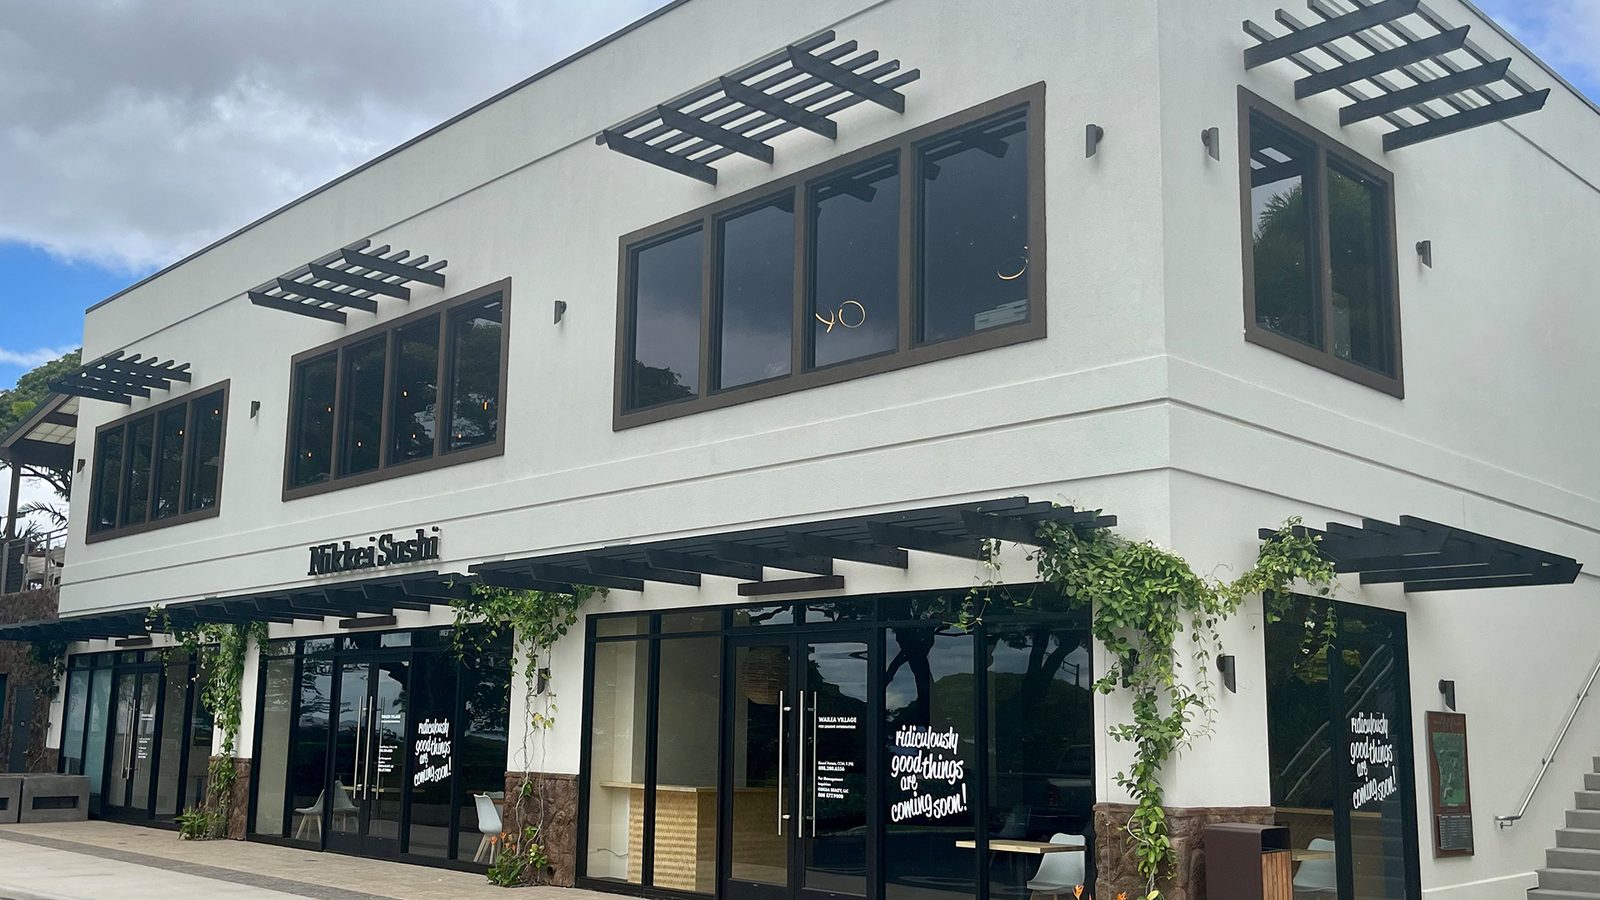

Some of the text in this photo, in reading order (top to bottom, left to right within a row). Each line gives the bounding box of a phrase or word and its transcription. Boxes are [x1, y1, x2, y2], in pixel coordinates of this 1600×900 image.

[308, 526, 440, 576] Nikkei Sushi
[415, 735, 451, 758] good things
[895, 724, 959, 755] ridiculously
[1350, 736, 1393, 768] good things
[414, 763, 435, 787] coming
[891, 749, 964, 785] good things
[900, 774, 918, 791] are
[891, 783, 968, 823] coming soon!
[1353, 765, 1397, 809] coming soon!
